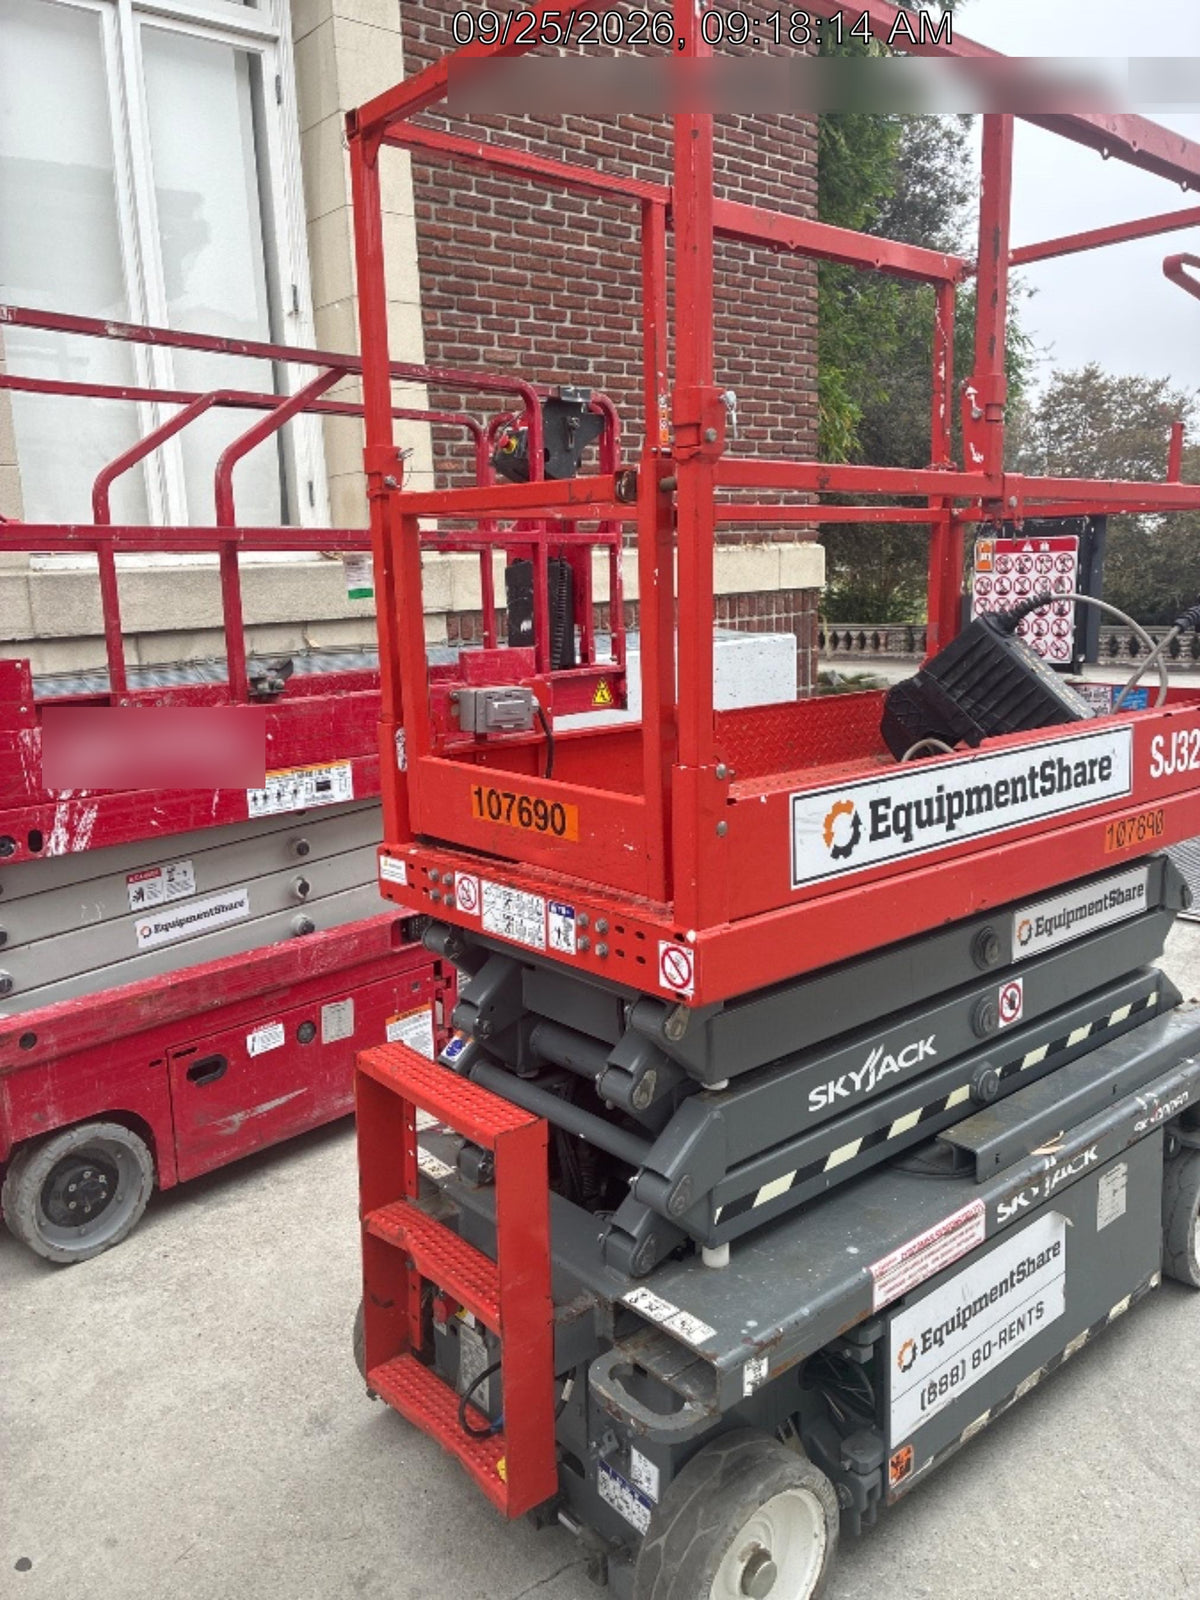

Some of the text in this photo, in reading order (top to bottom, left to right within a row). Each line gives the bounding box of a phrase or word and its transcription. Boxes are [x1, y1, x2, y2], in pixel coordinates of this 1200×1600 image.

[473, 786, 566, 836] 107690
[869, 754, 1112, 842] EquipmentShare
[154, 899, 245, 934] EquipmentShare
[1034, 883, 1144, 937] EquipmentShare
[808, 1034, 937, 1112] SKYJACK
[920, 1240, 1061, 1355] EquipmentShare
[920, 1301, 1044, 1410] (888) 80-RENTS
